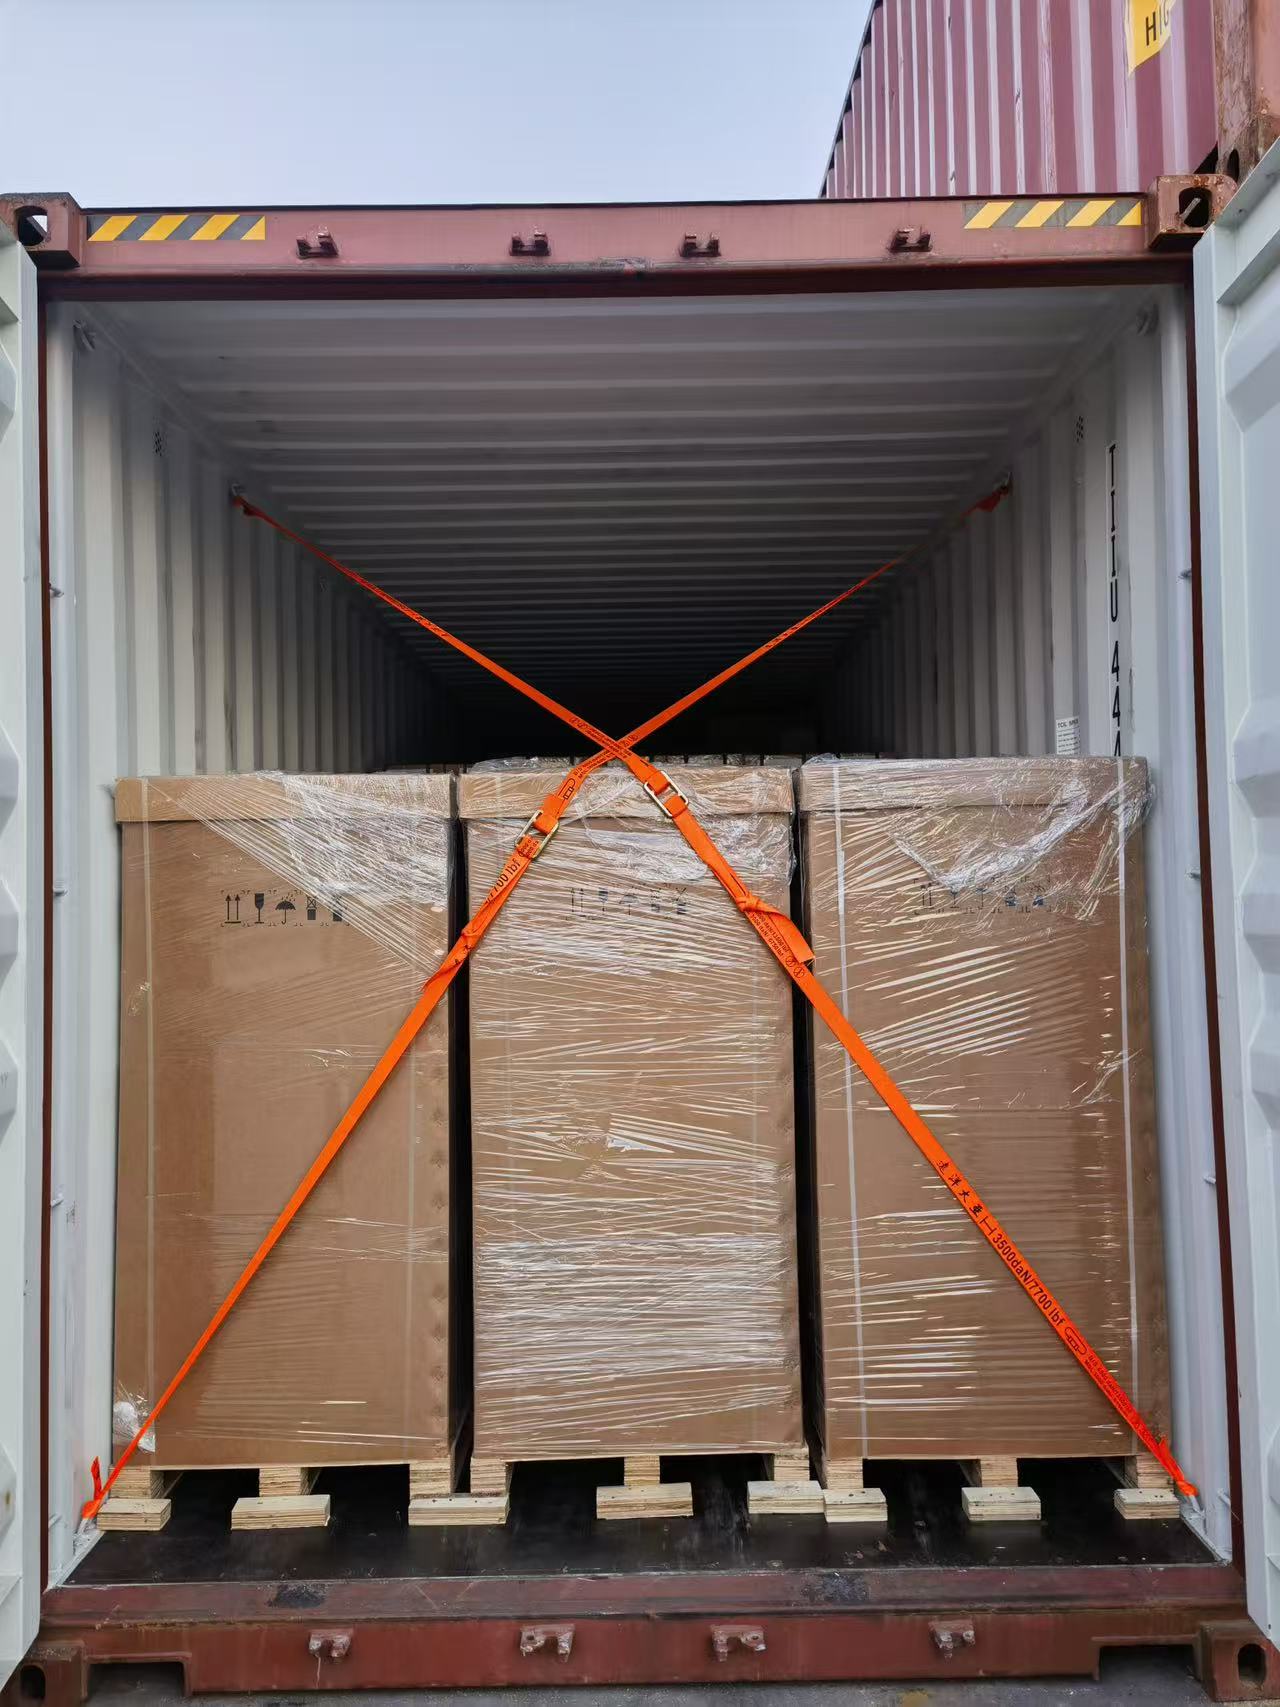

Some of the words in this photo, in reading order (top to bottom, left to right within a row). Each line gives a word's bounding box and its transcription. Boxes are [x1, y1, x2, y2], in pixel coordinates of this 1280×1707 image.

[505, 858, 521, 876] lbf
[992, 1233, 1053, 1310] 3500daN/7700
[1048, 1308, 1066, 1326] lbf
